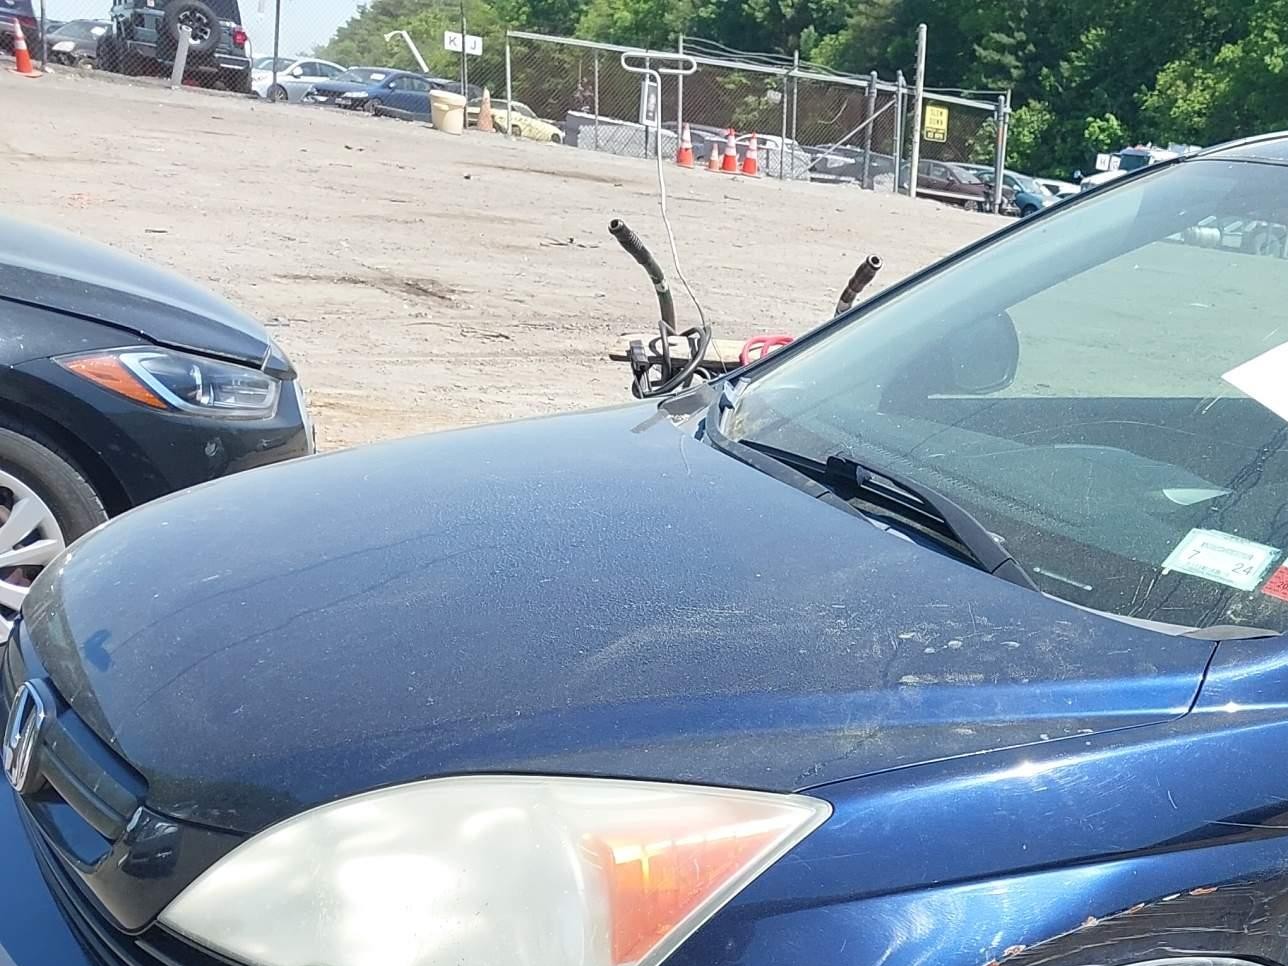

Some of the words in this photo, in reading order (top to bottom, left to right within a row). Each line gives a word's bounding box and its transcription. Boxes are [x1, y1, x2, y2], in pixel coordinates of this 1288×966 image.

[448, 36, 457, 47] K
[470, 40, 477, 50] J
[1187, 549, 1201, 560] 7
[1232, 562, 1254, 576] 24
